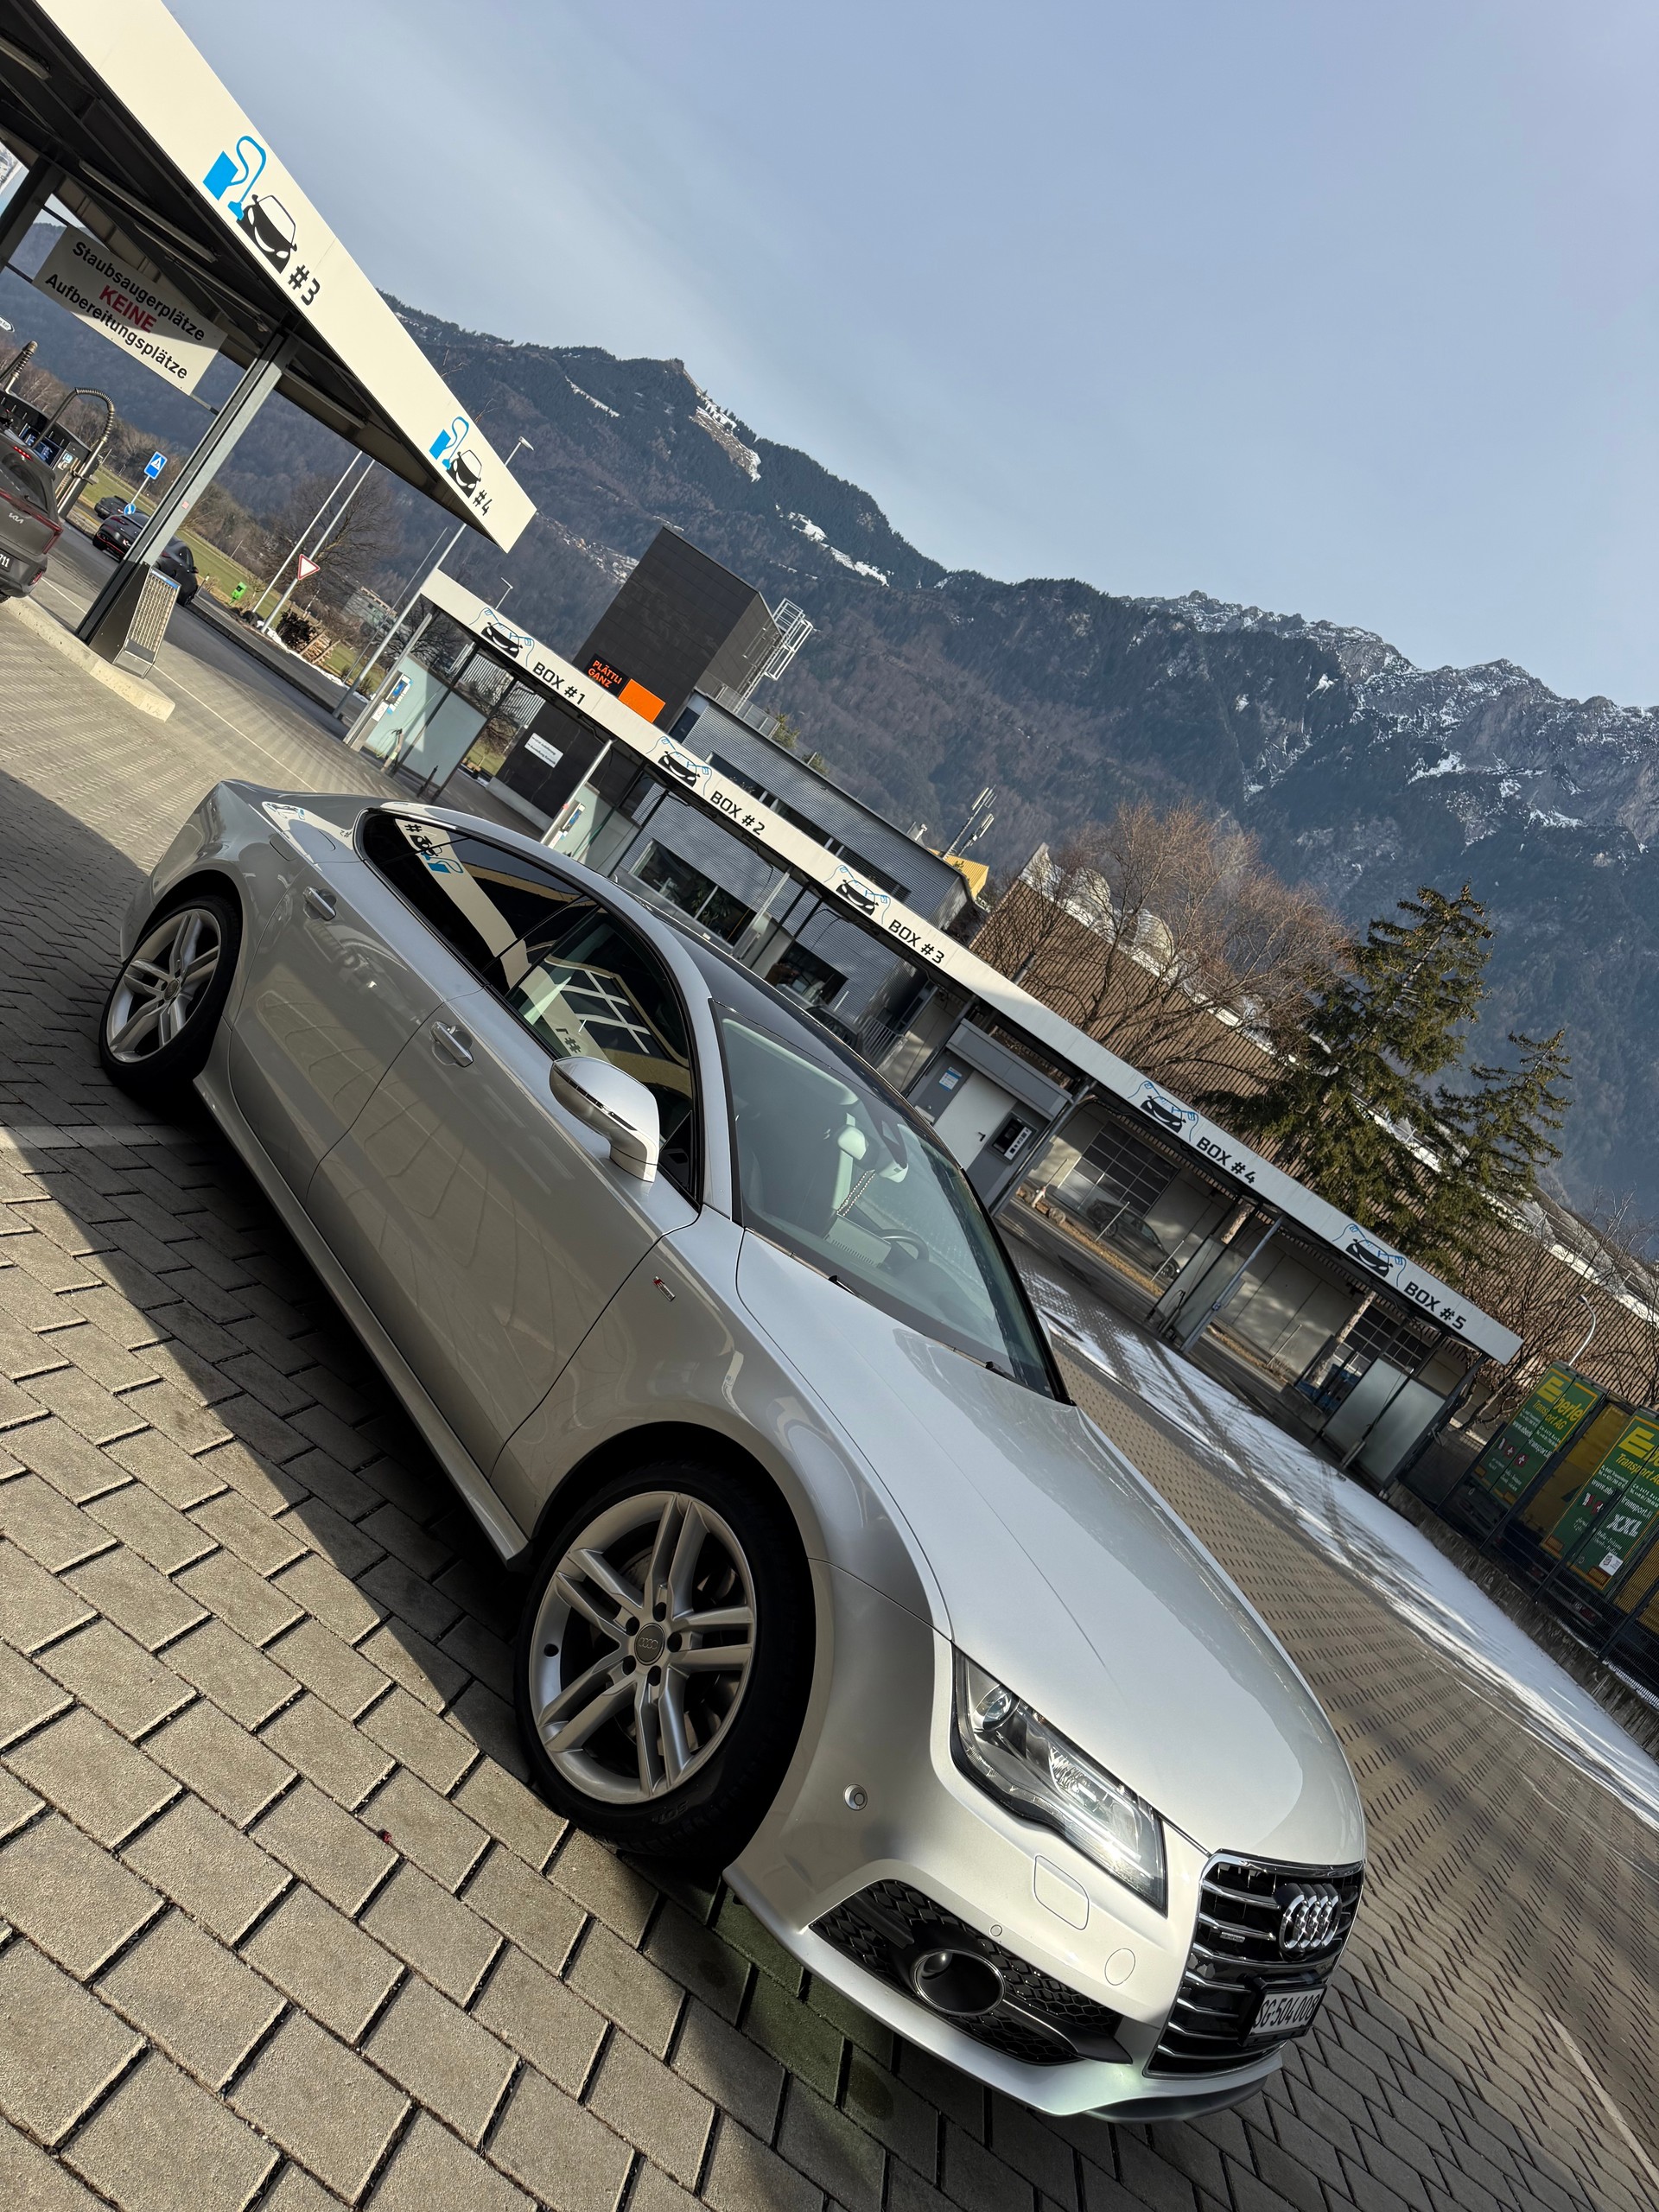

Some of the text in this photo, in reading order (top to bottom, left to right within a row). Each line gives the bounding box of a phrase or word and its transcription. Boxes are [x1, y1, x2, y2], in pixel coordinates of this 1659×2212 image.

[73, 241, 205, 341] Staubsaugerplätze
[288, 264, 321, 306] #3
[45, 273, 188, 379] Aufbereitungsplätze
[99, 284, 158, 334] KEINE
[473, 490, 493, 516] #4
[532, 661, 586, 705] BOX #1
[588, 668, 613, 689] GANZ
[593, 659, 623, 685] PLÄTTLI
[709, 790, 766, 836] BOX #2
[888, 918, 944, 964] BOX #3
[1196, 1136, 1256, 1185] BOX #4
[1403, 1281, 1467, 1331] BOX #5
[1554, 1418, 1567, 1431] AG
[1606, 1514, 1642, 1538] XXL
